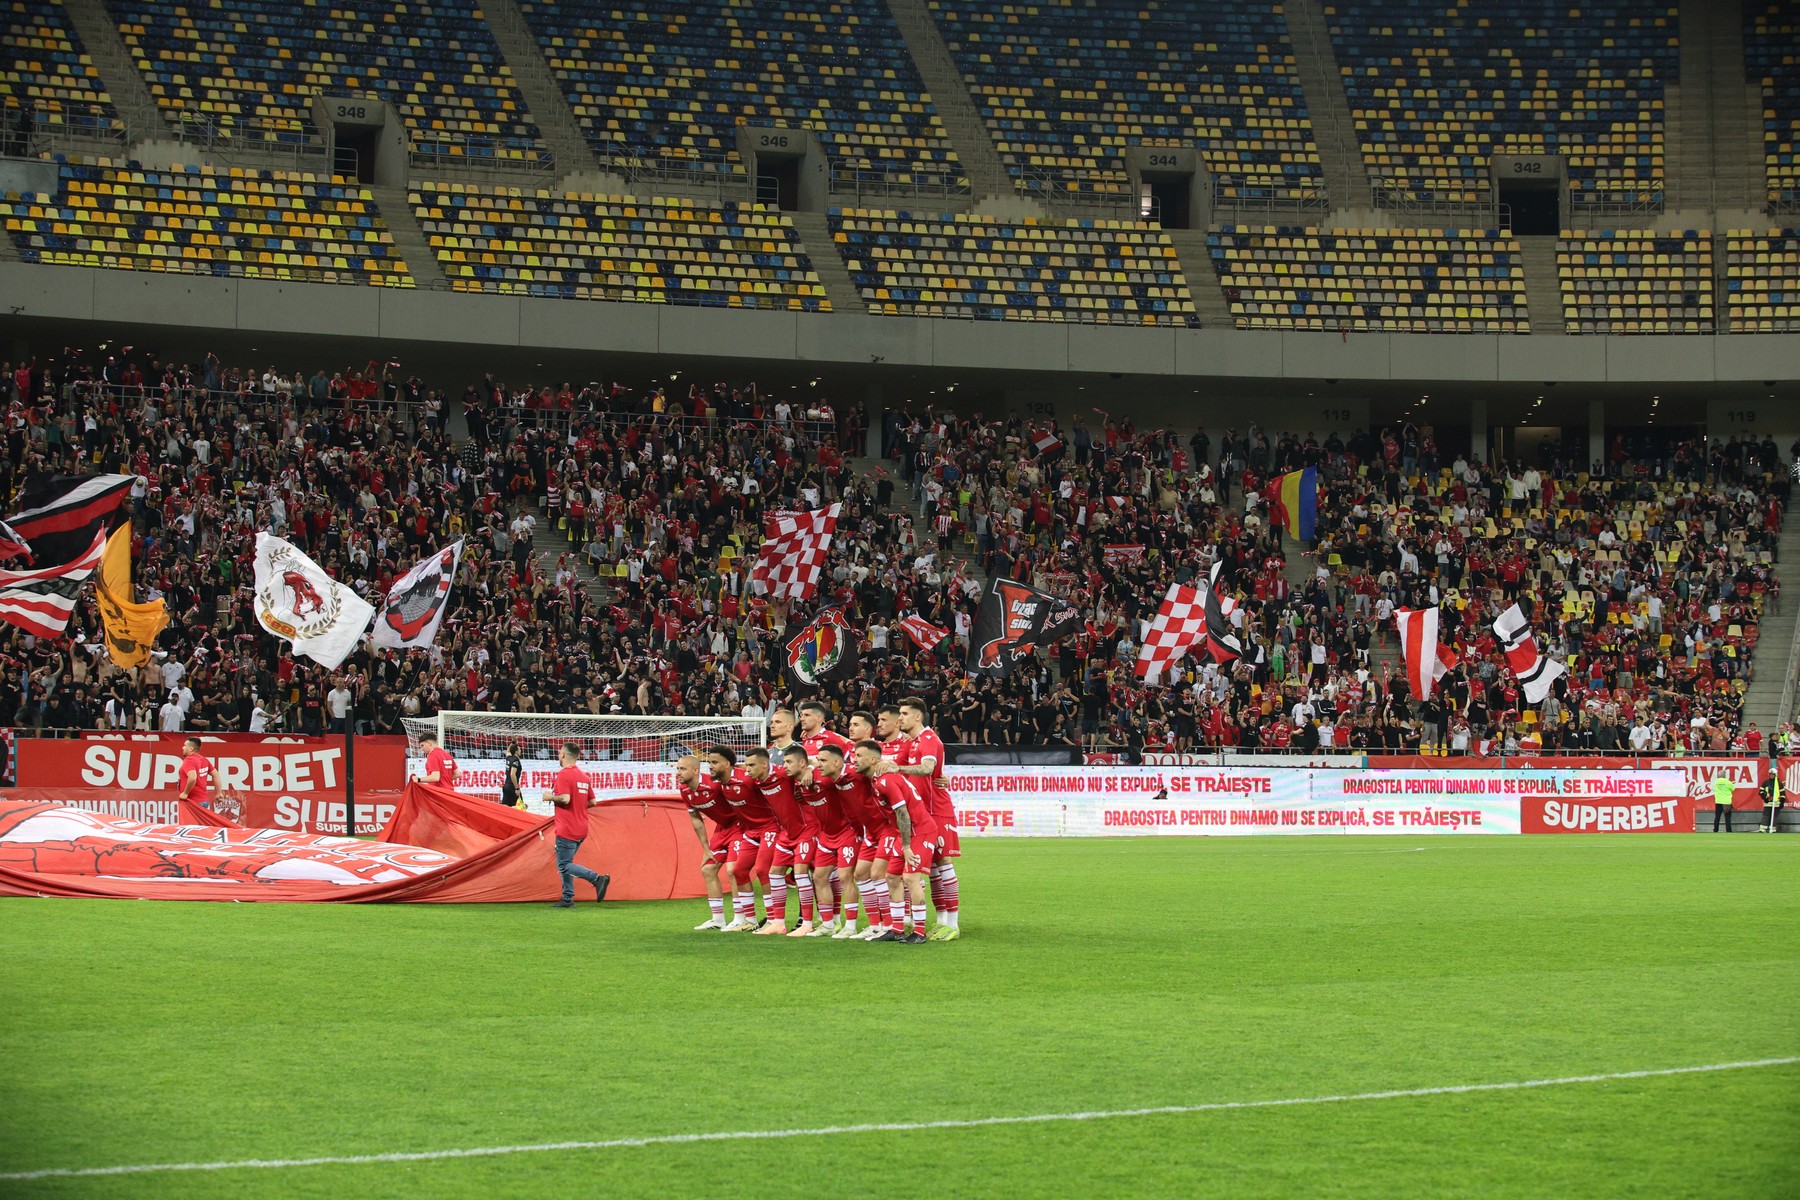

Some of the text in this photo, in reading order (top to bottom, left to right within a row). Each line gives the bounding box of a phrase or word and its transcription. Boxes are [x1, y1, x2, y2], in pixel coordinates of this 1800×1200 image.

[337, 105, 366, 119] 348
[760, 135, 788, 147] 346
[1149, 155, 1177, 166] 344
[1514, 162, 1541, 173] 342
[1025, 402, 1055, 415] 120
[1321, 409, 1350, 421] 119
[1727, 411, 1755, 422] 119
[996, 776, 1039, 792] PENTRU
[1041, 776, 1085, 792] DINAMO
[1087, 776, 1102, 792] NU
[1105, 776, 1118, 792] SE
[1170, 776, 1191, 792] SE
[1195, 773, 1271, 797] TRĂIEȘTE
[1343, 775, 1653, 797] DRAGOSTEA PENTRU DINAMO NU SE EXPLICĂ, SE TRĂIEȘTE
[1104, 807, 1481, 830] DRAGOSTEA PENTRU DINAMO NU SE EXPLICĂ, SE TRĂIEȘTE
[1543, 800, 1678, 831] SUPERBET
[764, 832, 776, 842] 27
[884, 836, 895, 848] 17
[799, 842, 809, 853] 10
[842, 847, 854, 858] 98
